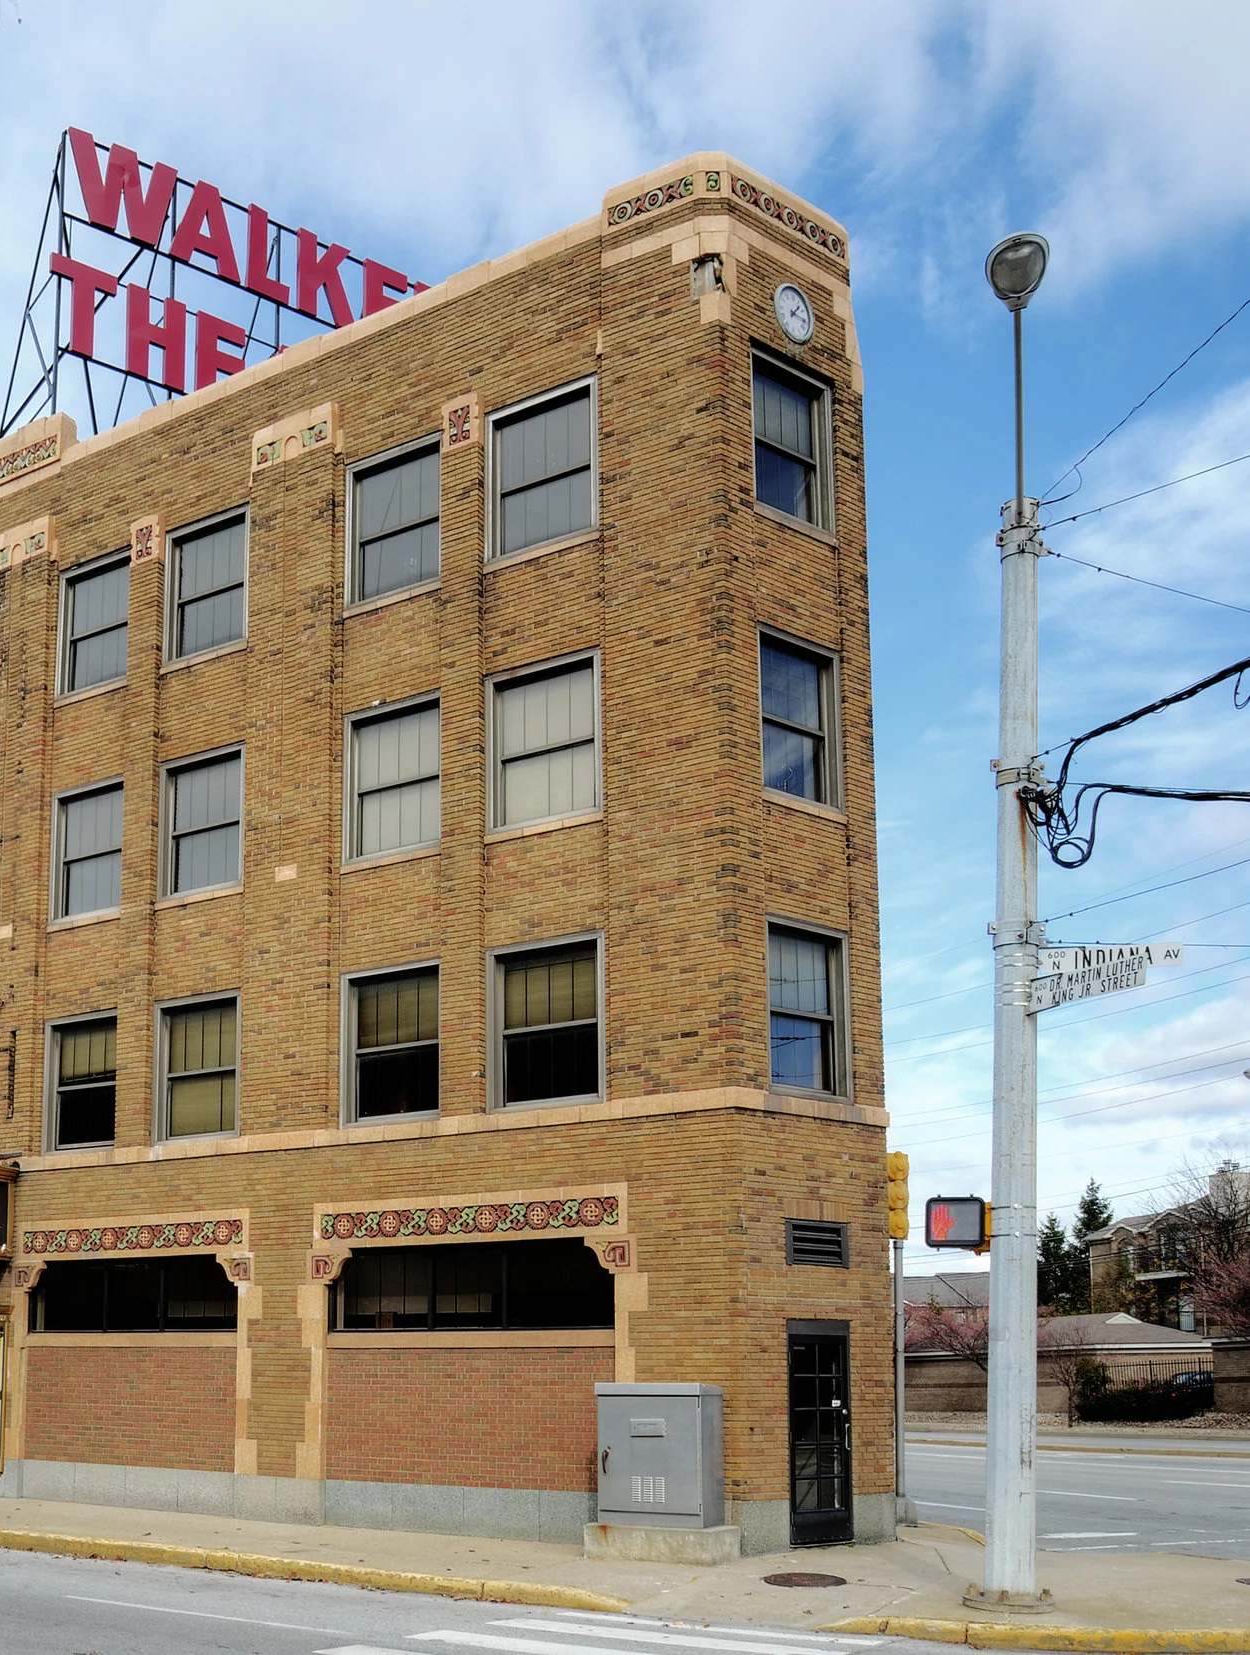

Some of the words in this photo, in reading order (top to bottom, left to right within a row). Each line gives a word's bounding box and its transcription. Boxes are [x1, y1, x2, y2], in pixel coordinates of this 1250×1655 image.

[68, 126, 432, 328] WALKE
[49, 252, 288, 391] THE
[1047, 951, 1066, 959] 600
[1163, 949, 1180, 959] AV
[1052, 961, 1060, 971] N
[1036, 995, 1043, 1004] N
[1051, 988, 1074, 1005] KING
[1078, 985, 1093, 998] JR.
[1100, 972, 1139, 993] STREET
[1049, 977, 1063, 992] DR.
[1067, 966, 1101, 987] MARTIN
[1106, 956, 1144, 978] LUTHER
